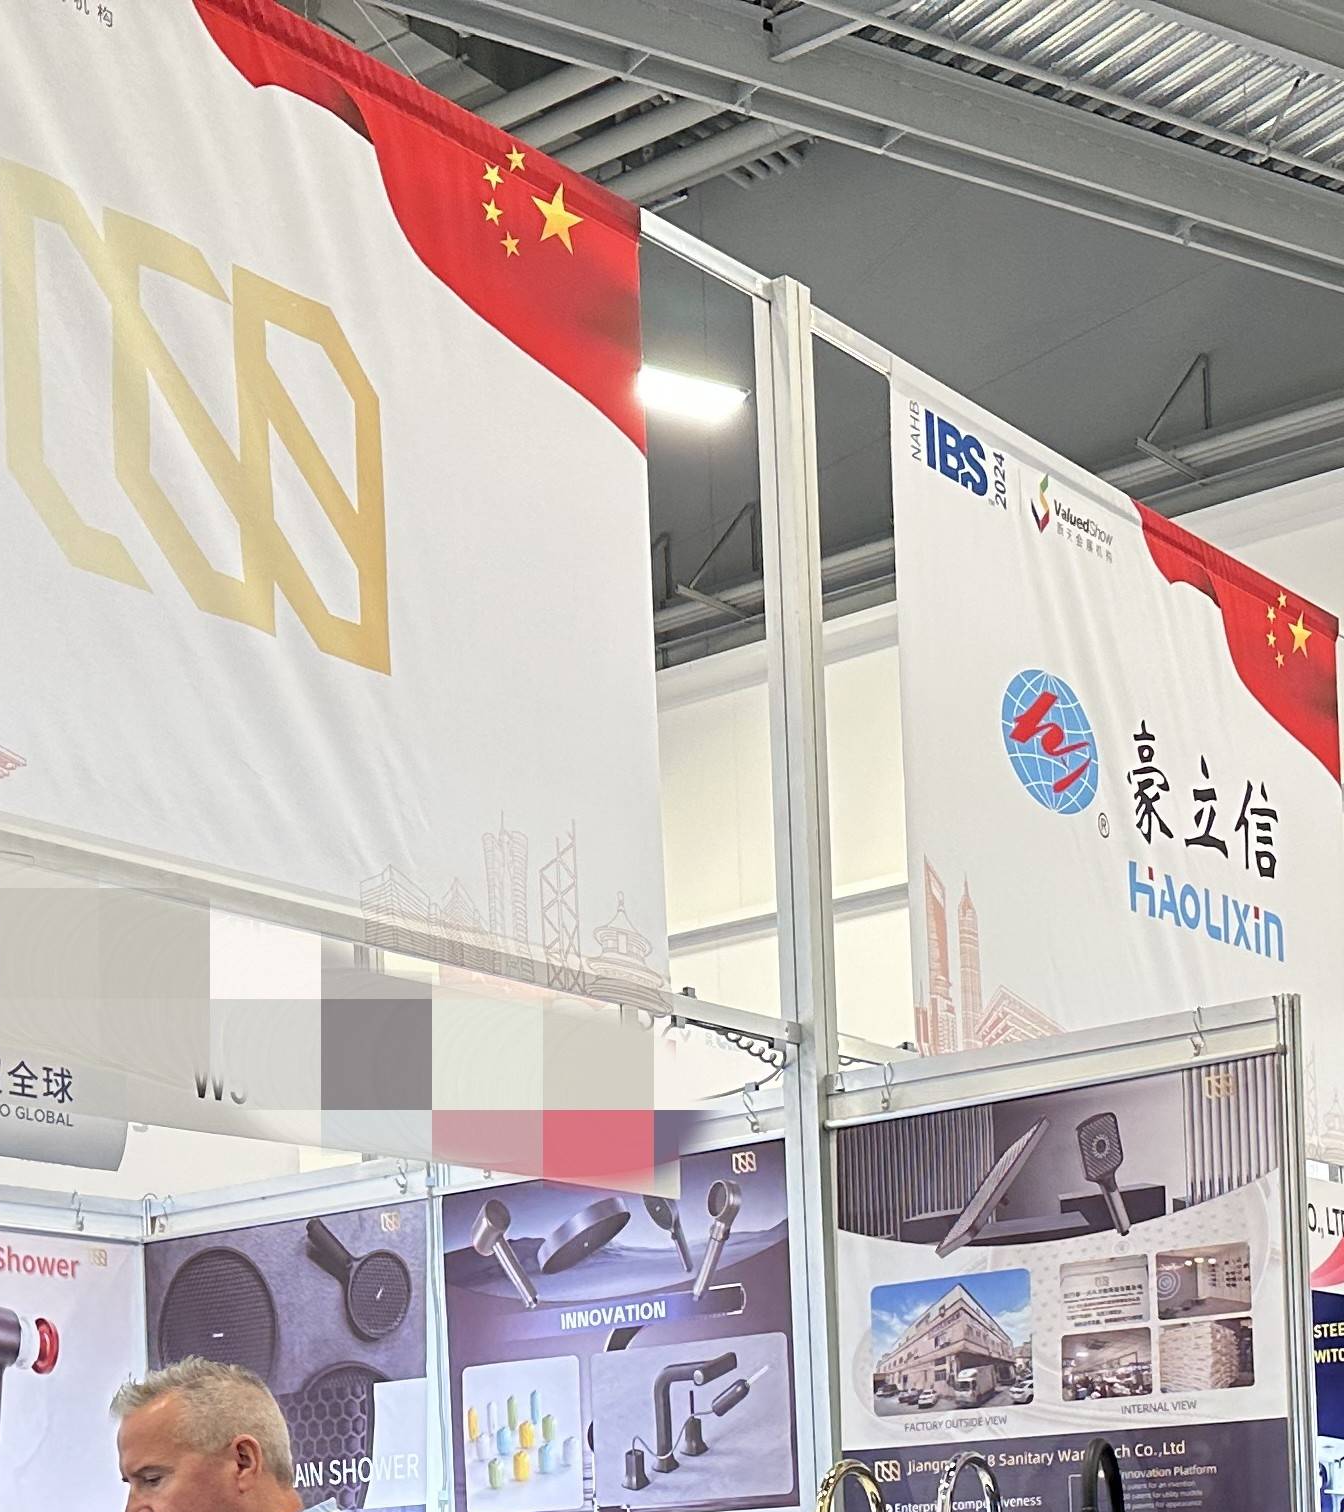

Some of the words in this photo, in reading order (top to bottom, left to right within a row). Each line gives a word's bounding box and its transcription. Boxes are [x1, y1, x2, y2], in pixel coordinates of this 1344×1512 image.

[908, 399, 922, 462] NAHB
[924, 408, 989, 498] IBS
[992, 451, 1007, 511] 2024
[1054, 498, 1114, 547] ValuedShow
[1126, 719, 1279, 880] 豪立信
[15, 1106, 75, 1128] GLOBAL
[559, 1299, 667, 1330] INNOVATION
[904, 1420, 944, 1433] FACTORY
[944, 1416, 983, 1430] OUTSIDE
[985, 1415, 1008, 1426] VIEW
[1121, 1403, 1170, 1415] INTERNAL
[1171, 1400, 1198, 1411] VIEW
[998, 1450, 1054, 1467] Sanitary
[1057, 1449, 1087, 1462] War
[1134, 1440, 1186, 1459] Co.,Ltd
[293, 1461, 324, 1489] AIN
[328, 1453, 420, 1486] SHOWER
[1121, 1467, 1172, 1479] nnovation
[1172, 1463, 1217, 1477] Platform
